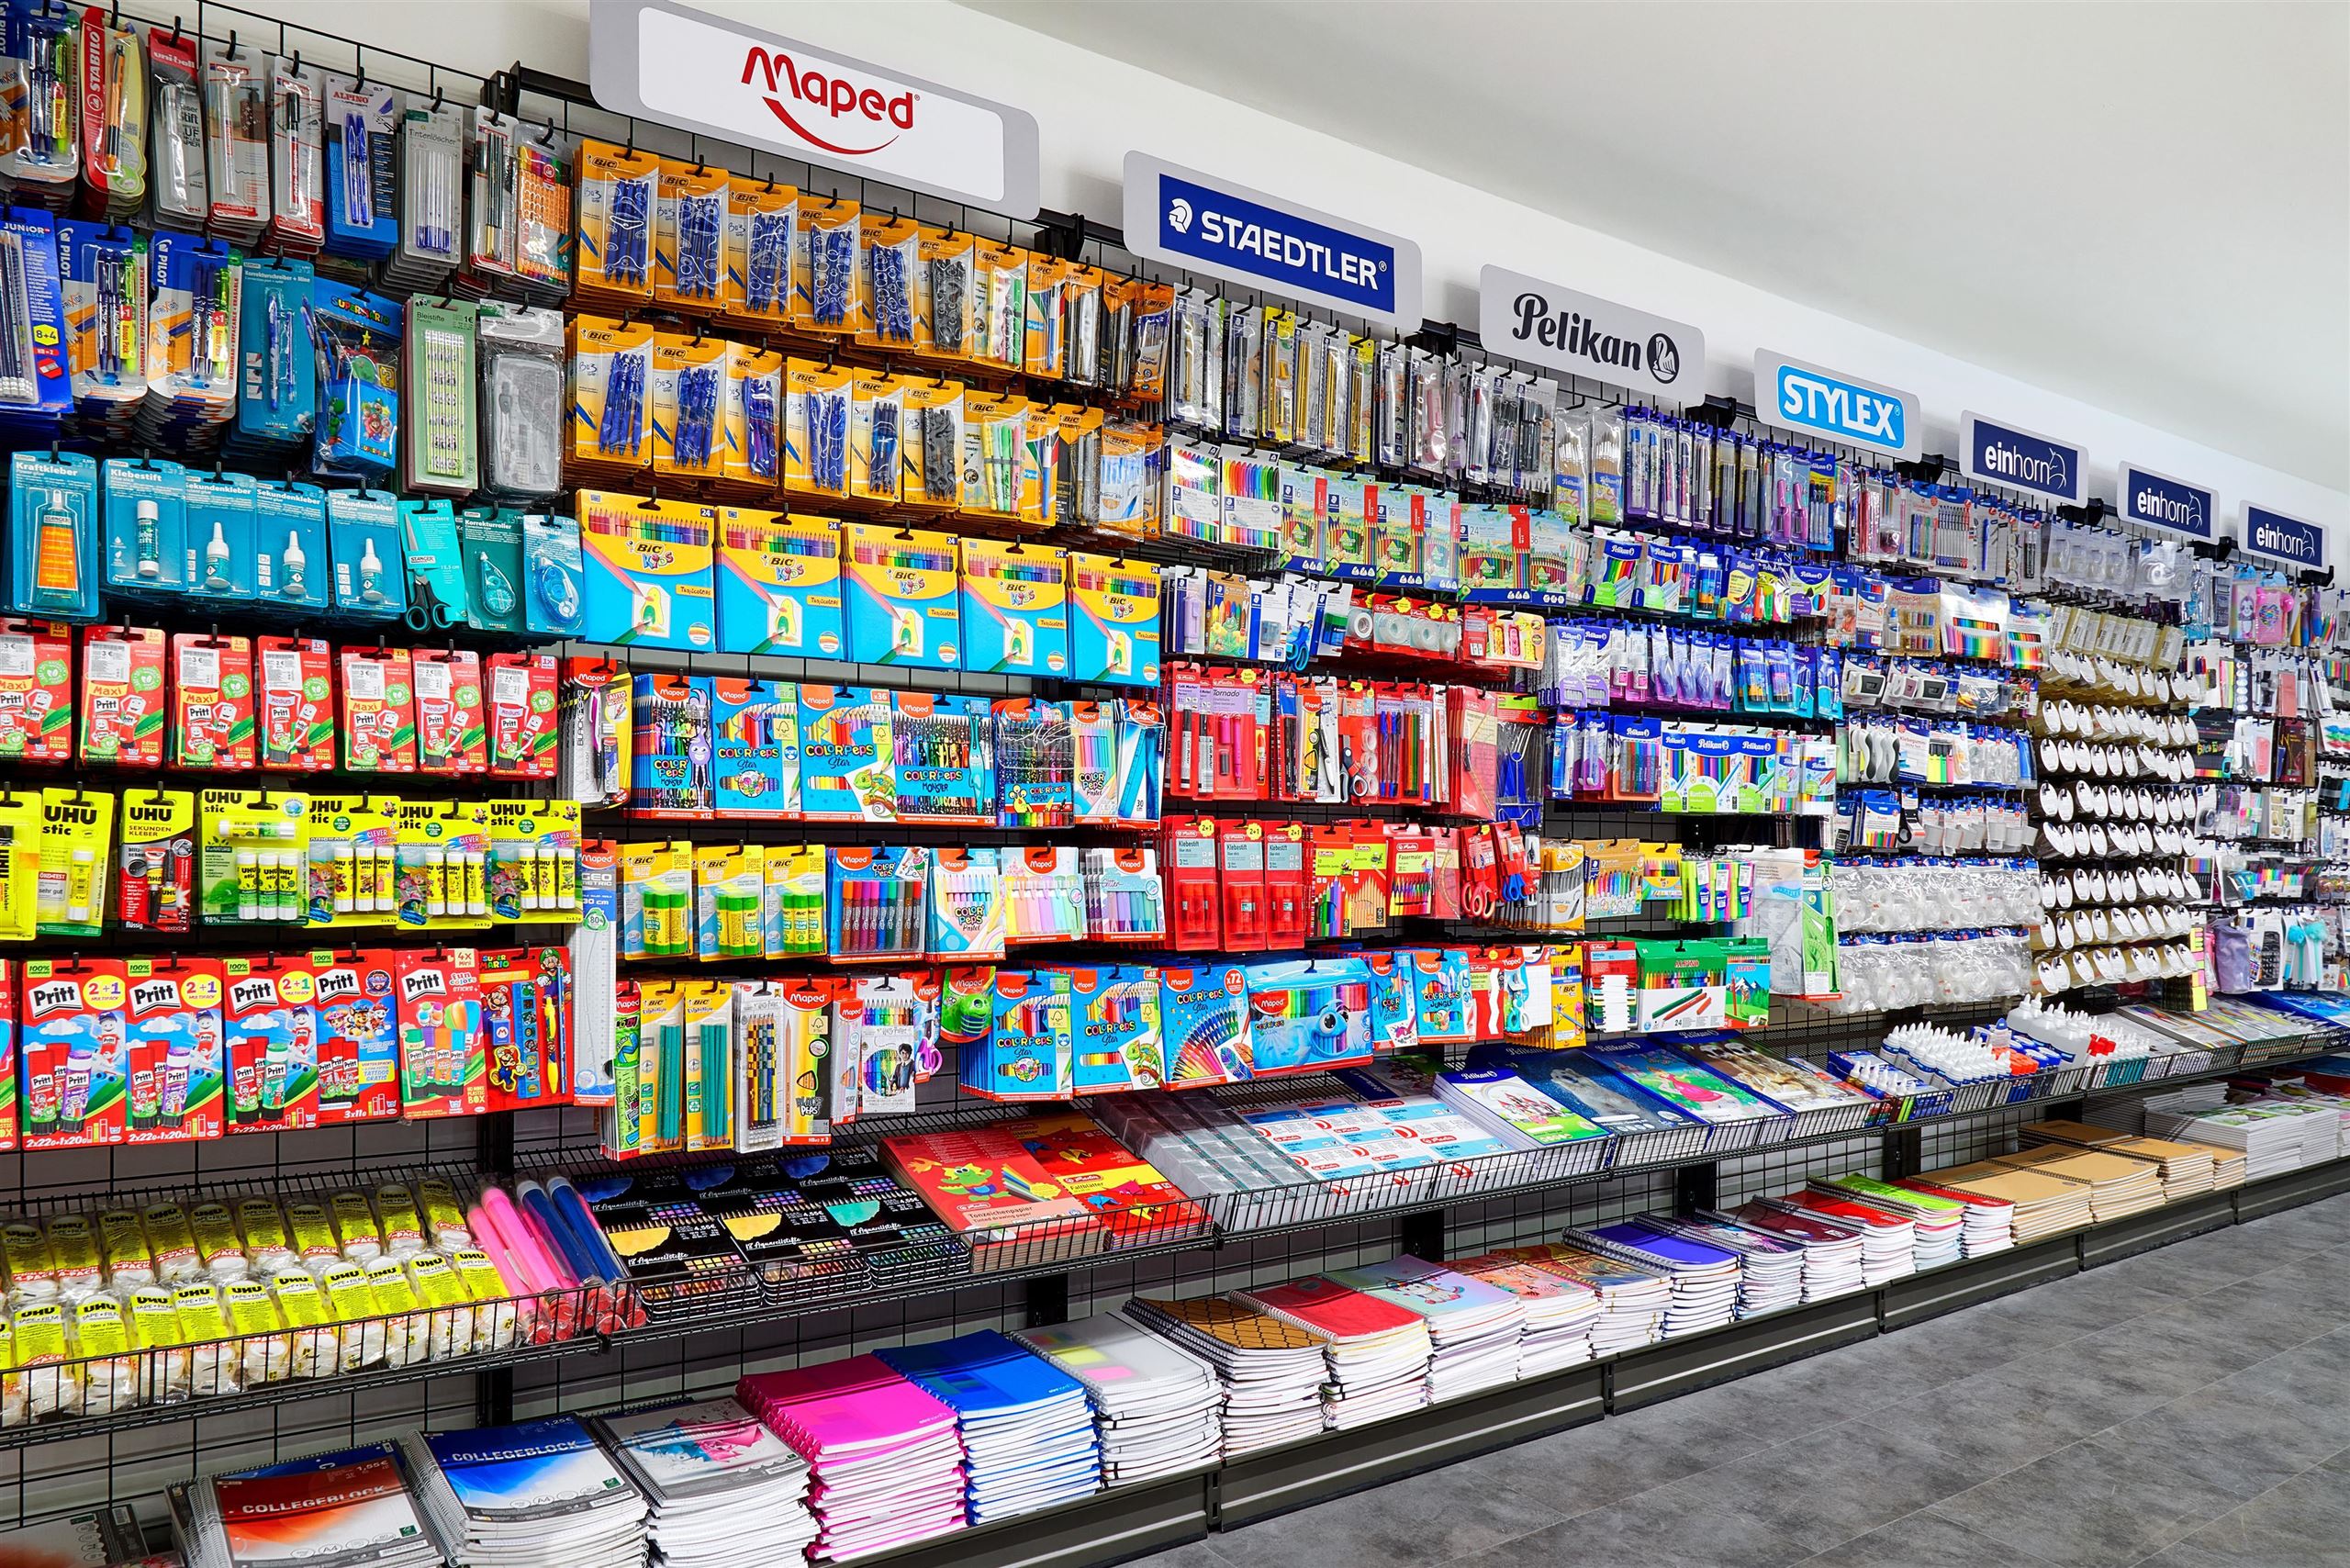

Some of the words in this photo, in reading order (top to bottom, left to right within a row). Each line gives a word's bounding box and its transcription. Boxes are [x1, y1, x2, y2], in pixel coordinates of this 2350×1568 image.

[89, 30, 101, 93] STABILO
[741, 47, 914, 129] Maped
[333, 91, 369, 104] ALPINO
[408, 129, 457, 146] Tintenlöscher
[1201, 210, 1378, 290] STAEDTLER
[60, 244, 72, 278] PILOT
[157, 252, 169, 286] PILOT
[417, 311, 445, 322] Bleistifte
[36, 330, 58, 341] 8+4
[1512, 293, 1641, 371] Pelikan
[1784, 375, 1897, 441] STYLEX
[16, 462, 78, 476] Kraftkleber
[1985, 442, 2051, 486] einhorn
[110, 468, 162, 482] Klebestift
[256, 488, 321, 505] Sekundenkleber
[331, 498, 394, 512] Sekundenkleber
[2137, 488, 2190, 525] einhorn
[702, 510, 711, 518] 24
[464, 520, 512, 531] Korrekturroller
[2256, 521, 2304, 557] einhorn
[1611, 544, 1629, 556] Pelikan
[578, 674, 606, 683] Maped
[93, 686, 122, 696] Maxi
[660, 689, 685, 699] Maped
[722, 690, 746, 700] Maped
[1213, 689, 1240, 698] Tornado
[186, 694, 214, 704] Maxi
[808, 697, 831, 706] Maped
[95, 700, 118, 711] Pritt
[352, 702, 378, 712] Maxi
[904, 705, 929, 713] Maped
[190, 707, 210, 717] Pritt
[356, 715, 375, 724] Pritt
[502, 719, 517, 728] Pritt
[1627, 728, 1644, 737] Pelikan
[1698, 739, 1721, 750] Pelikan
[1742, 741, 1764, 751] Pelikan
[204, 790, 242, 804] UHU
[44, 805, 97, 824] UHU
[129, 807, 172, 822] UHU
[204, 805, 225, 813] stic
[491, 803, 526, 816] UHU
[491, 817, 514, 826] stic
[41, 824, 72, 836] stic
[367, 829, 387, 838] CLEVER
[459, 835, 479, 845] CLEVER
[1179, 840, 1200, 848] Klebestift
[581, 854, 613, 864] Maped
[844, 855, 867, 865] Maped
[1030, 859, 1052, 868] Maped
[1119, 860, 1141, 868] Maped
[582, 872, 613, 881] GEO
[129, 964, 150, 972] 100%
[479, 959, 509, 969] MARIO
[320, 975, 354, 993] Pritt
[406, 976, 440, 993] Pritt
[1226, 973, 1242, 985] x72
[135, 985, 173, 1005] Pritt
[235, 982, 271, 1002] Pritt
[1002, 985, 1024, 994] Maped
[35, 986, 76, 1007] Pritt
[789, 991, 827, 1003] Maped
[1260, 998, 1284, 1008] Maped
[968, 1204, 1033, 1220] Tonzeichenpapier
[416, 1257, 443, 1267] UHU
[279, 1276, 309, 1284] UHU
[21, 1307, 55, 1318] UHU
[84, 1304, 116, 1313] UHU
[452, 1439, 579, 1463] COLLEGEBLOCK
[242, 1485, 386, 1515] COLLEGEBLOCK
